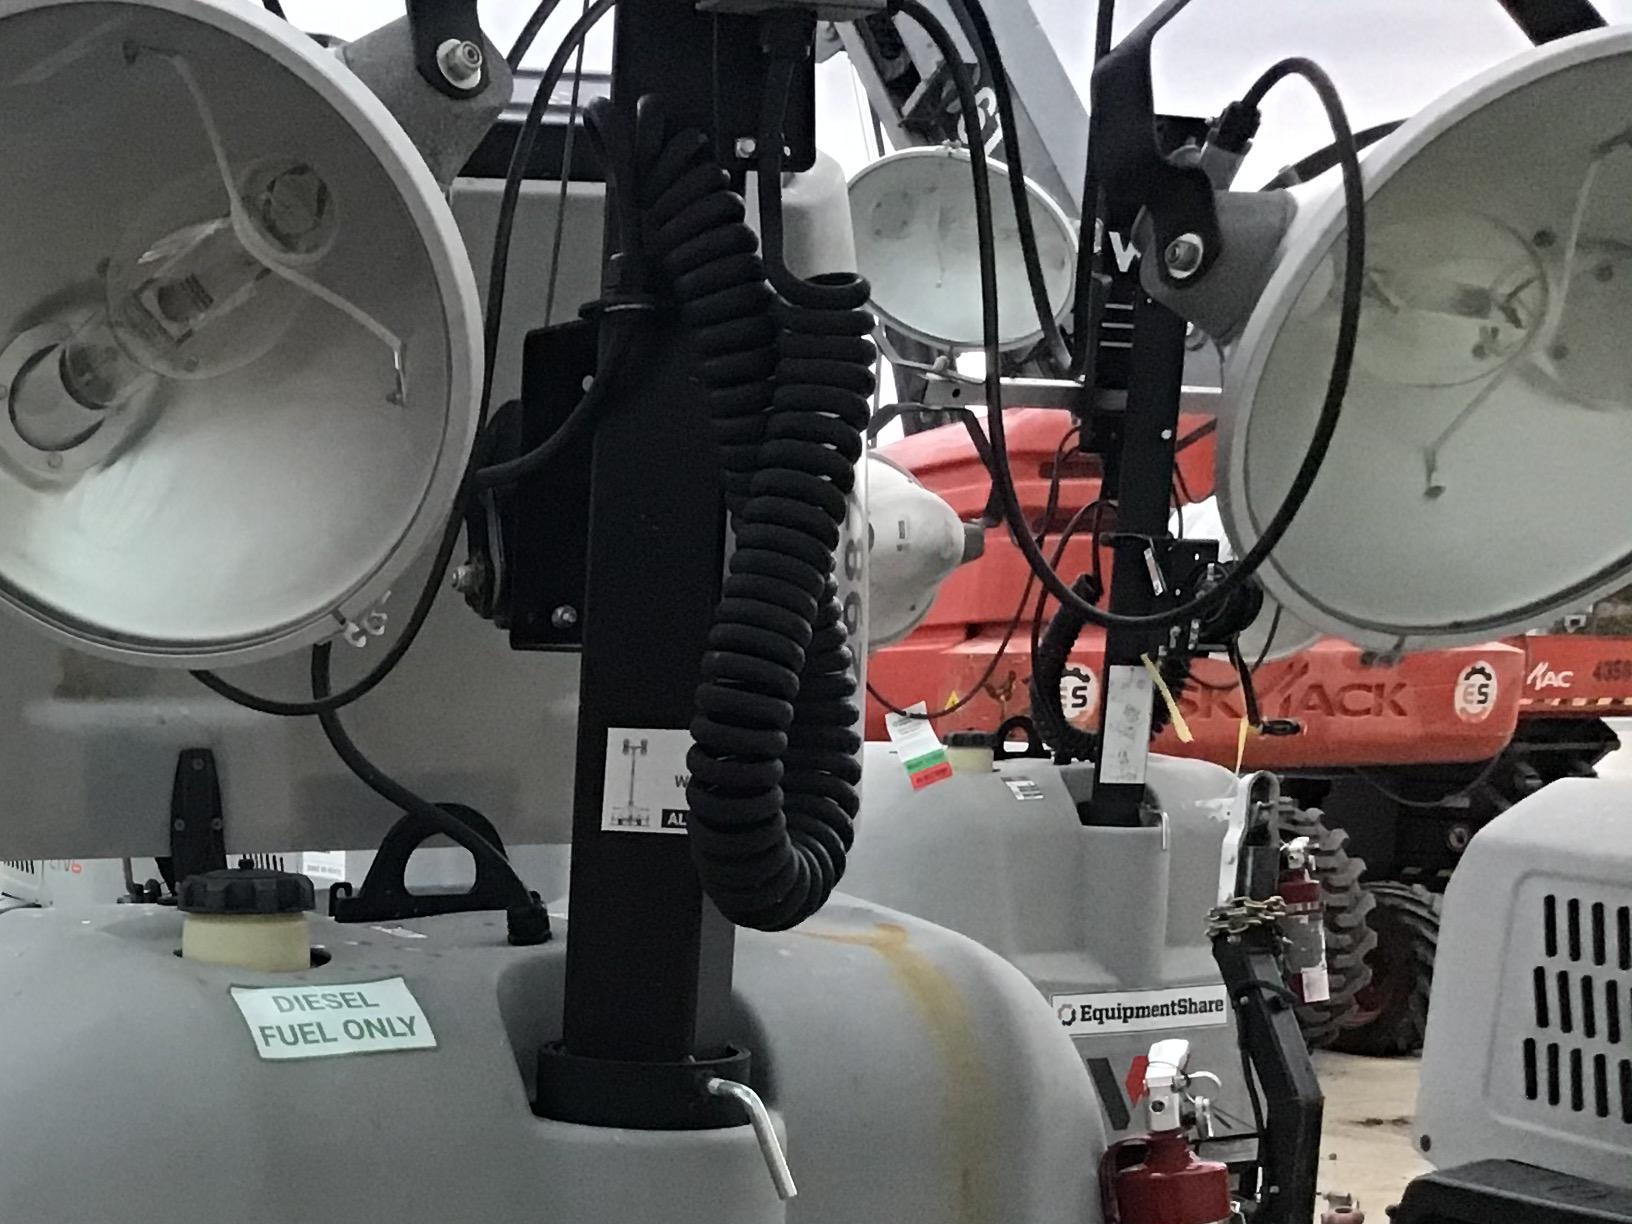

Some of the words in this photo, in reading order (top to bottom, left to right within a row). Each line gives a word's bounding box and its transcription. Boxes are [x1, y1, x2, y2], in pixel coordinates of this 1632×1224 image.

[272, 991, 381, 1014] DIESEL
[1079, 997, 1225, 1025] EquipmentShare
[258, 1021, 339, 1047] FUEL
[342, 1015, 416, 1041] ONLY
